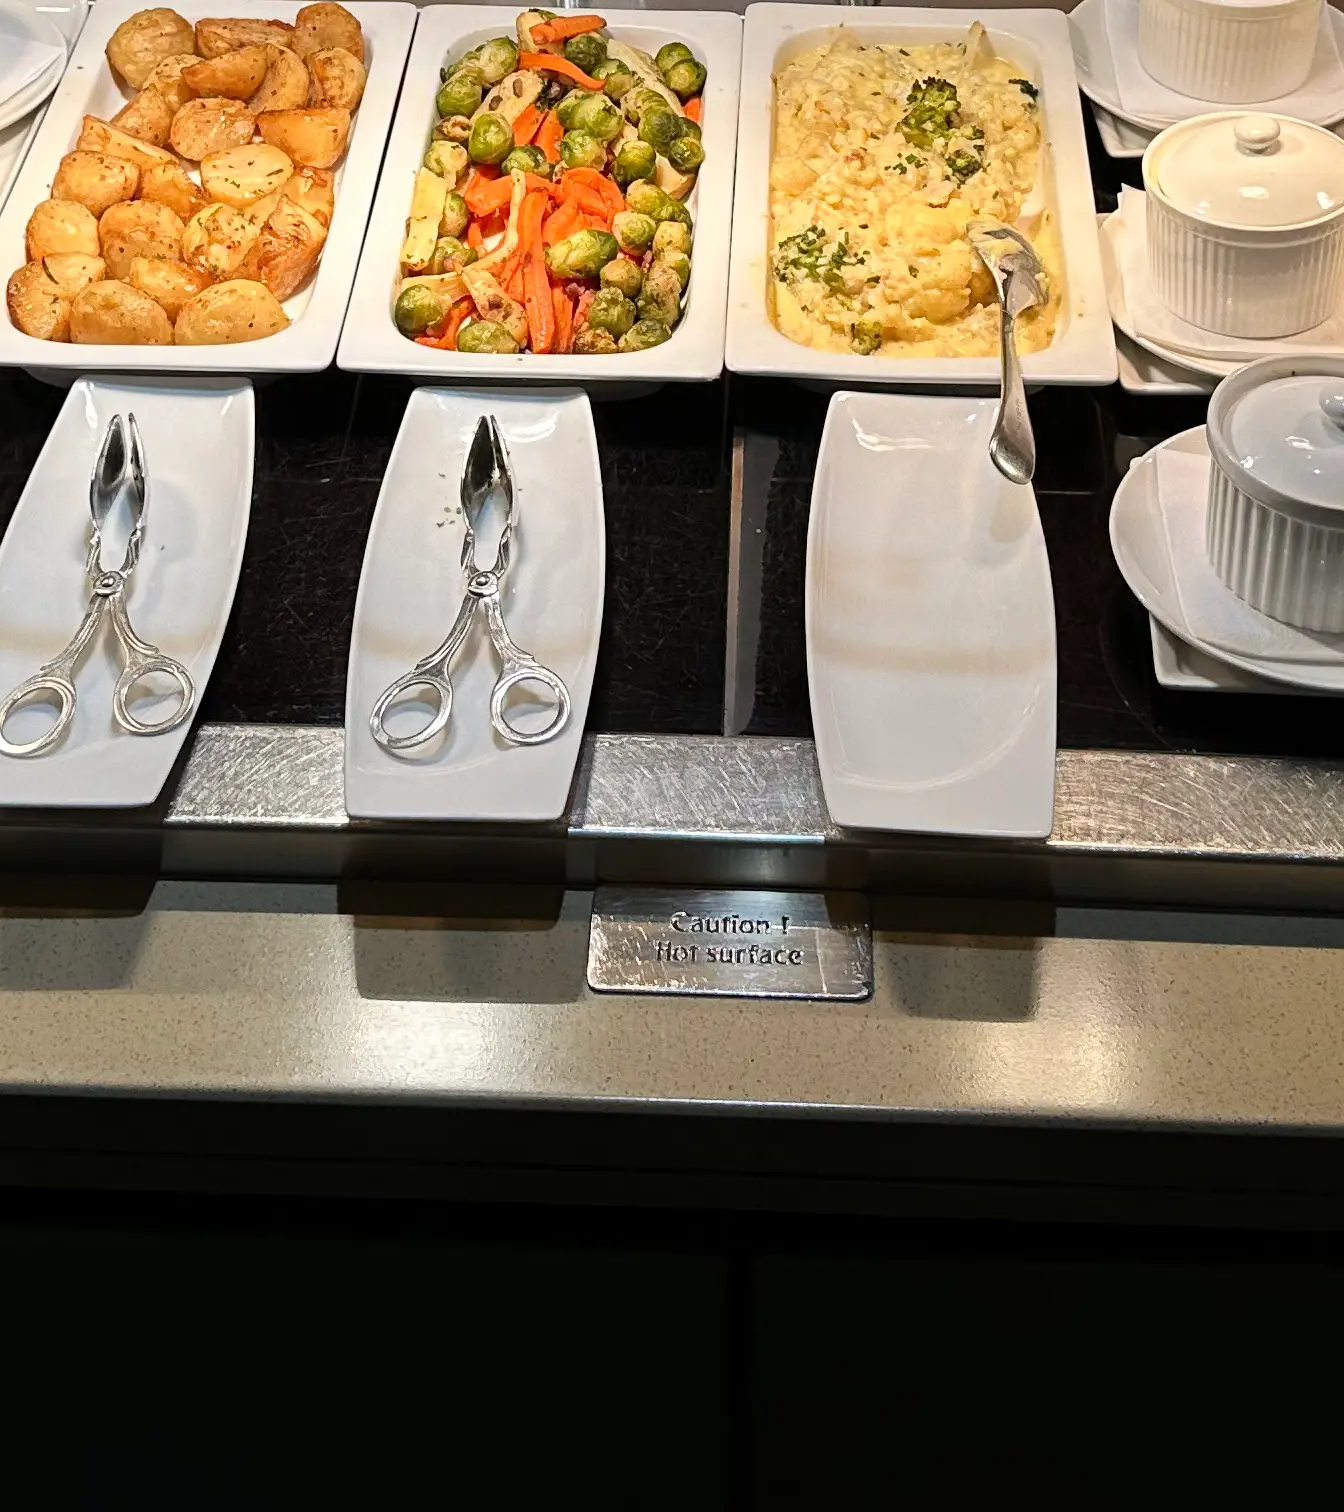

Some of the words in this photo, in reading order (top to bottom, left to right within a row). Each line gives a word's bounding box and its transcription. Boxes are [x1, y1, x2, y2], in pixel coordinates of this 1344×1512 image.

[670, 911, 770, 935] Caution
[656, 941, 699, 962] Hot
[706, 944, 805, 966] surface
